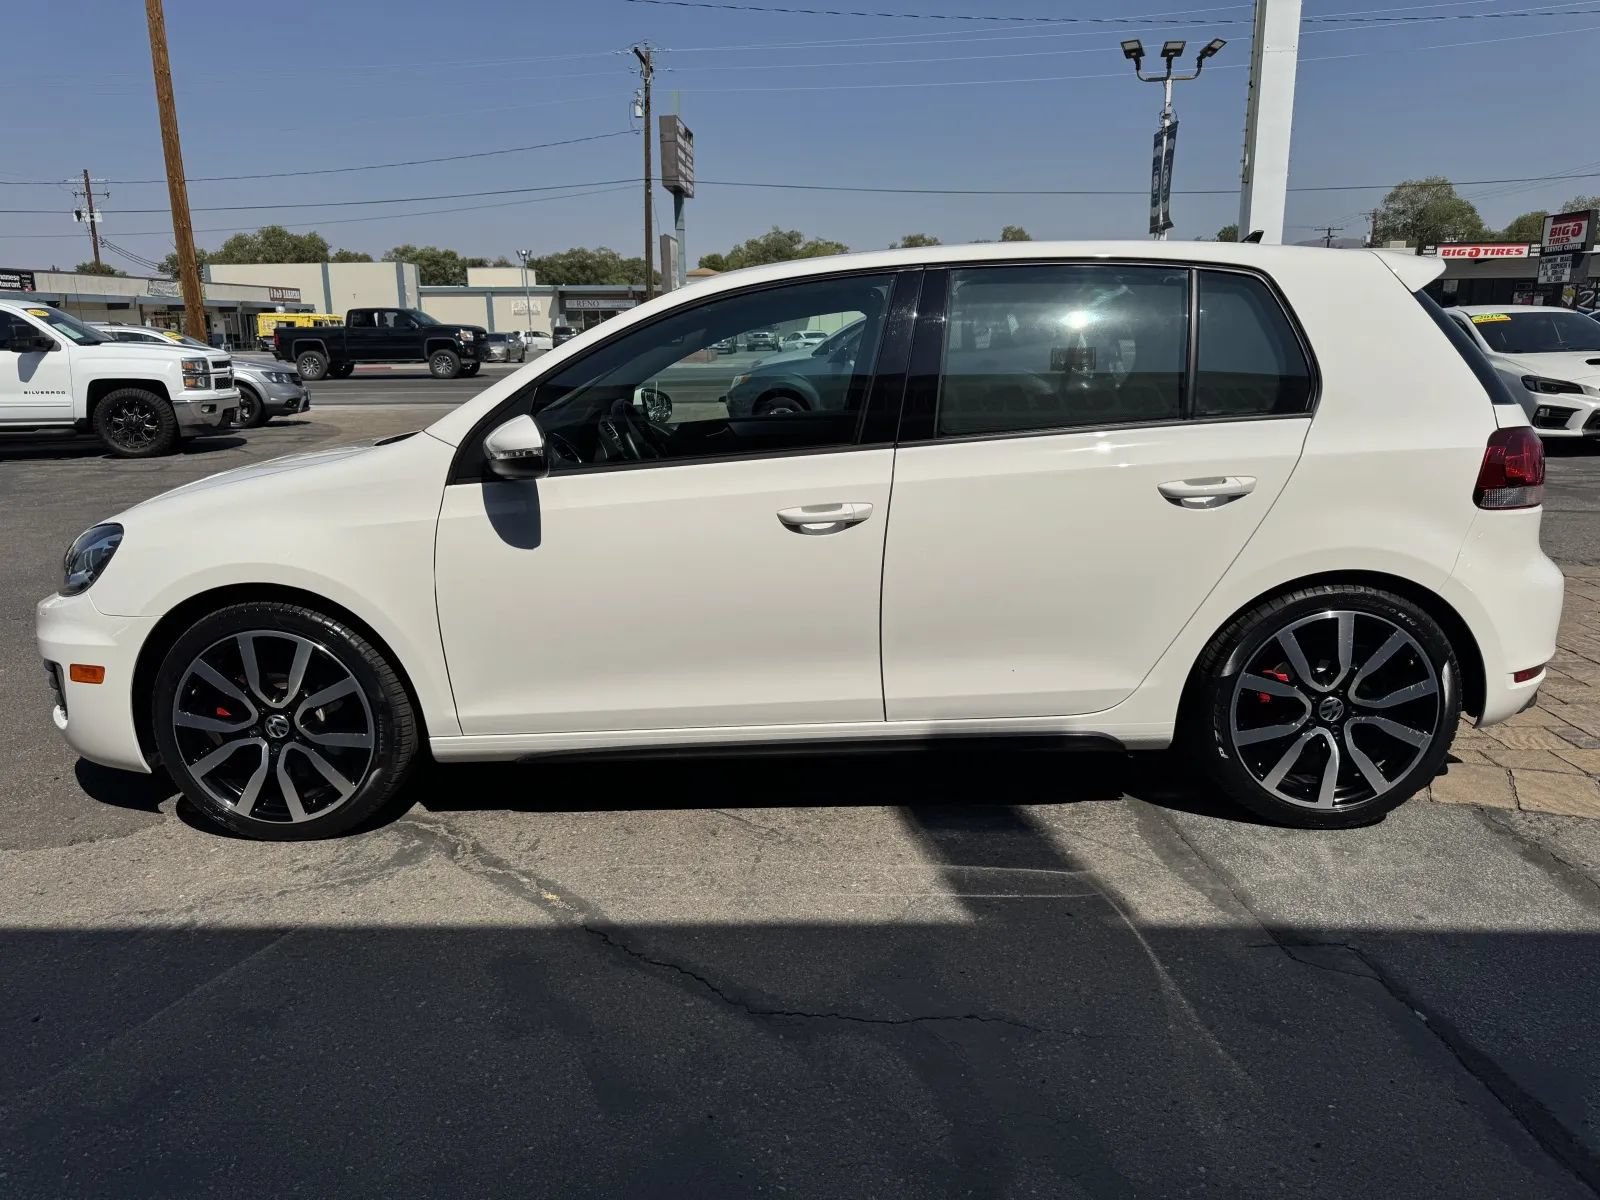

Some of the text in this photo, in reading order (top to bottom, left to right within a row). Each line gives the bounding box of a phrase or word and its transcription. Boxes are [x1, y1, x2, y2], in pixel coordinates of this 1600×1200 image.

[1548, 236, 1570, 245] TIRES
[1441, 248, 1467, 257] BIG
[1482, 247, 1524, 256] TIRES
[576, 300, 600, 308] RENO
